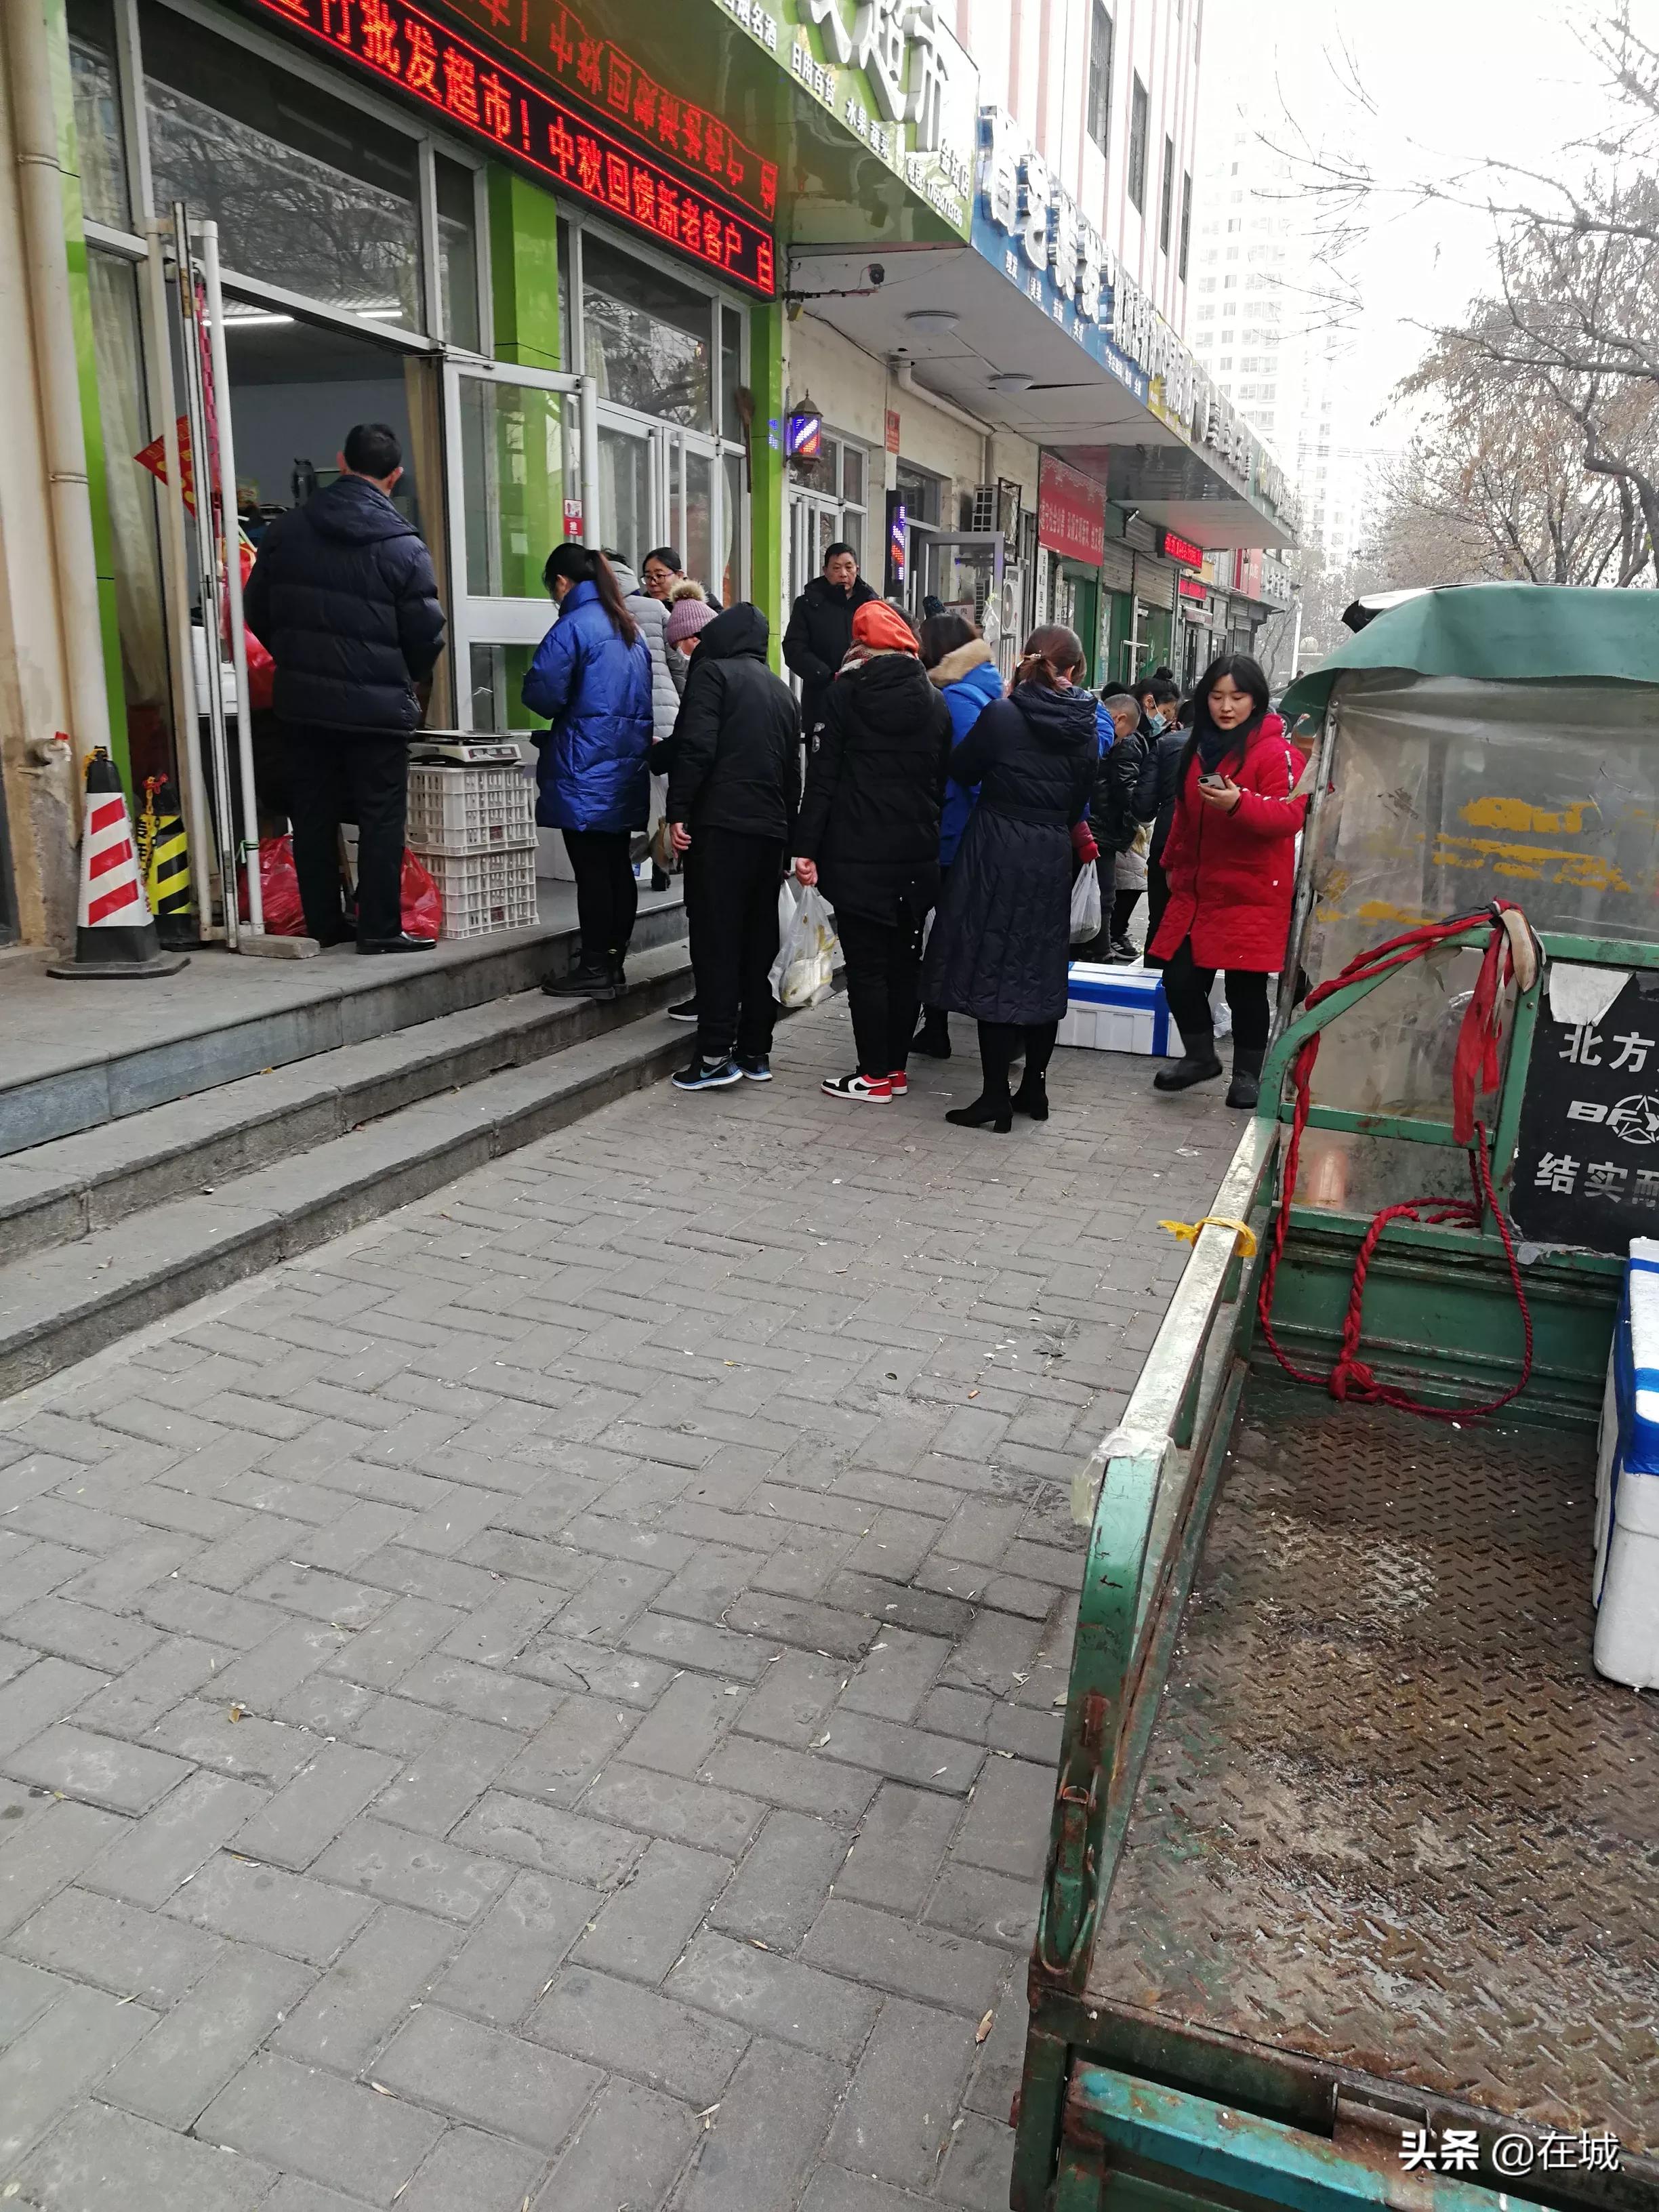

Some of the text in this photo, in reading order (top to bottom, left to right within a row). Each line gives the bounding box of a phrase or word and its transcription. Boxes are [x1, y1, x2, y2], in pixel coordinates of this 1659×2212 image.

[792, 41, 835, 108] 日用百货
[1559, 1024, 1659, 1073] 北方
